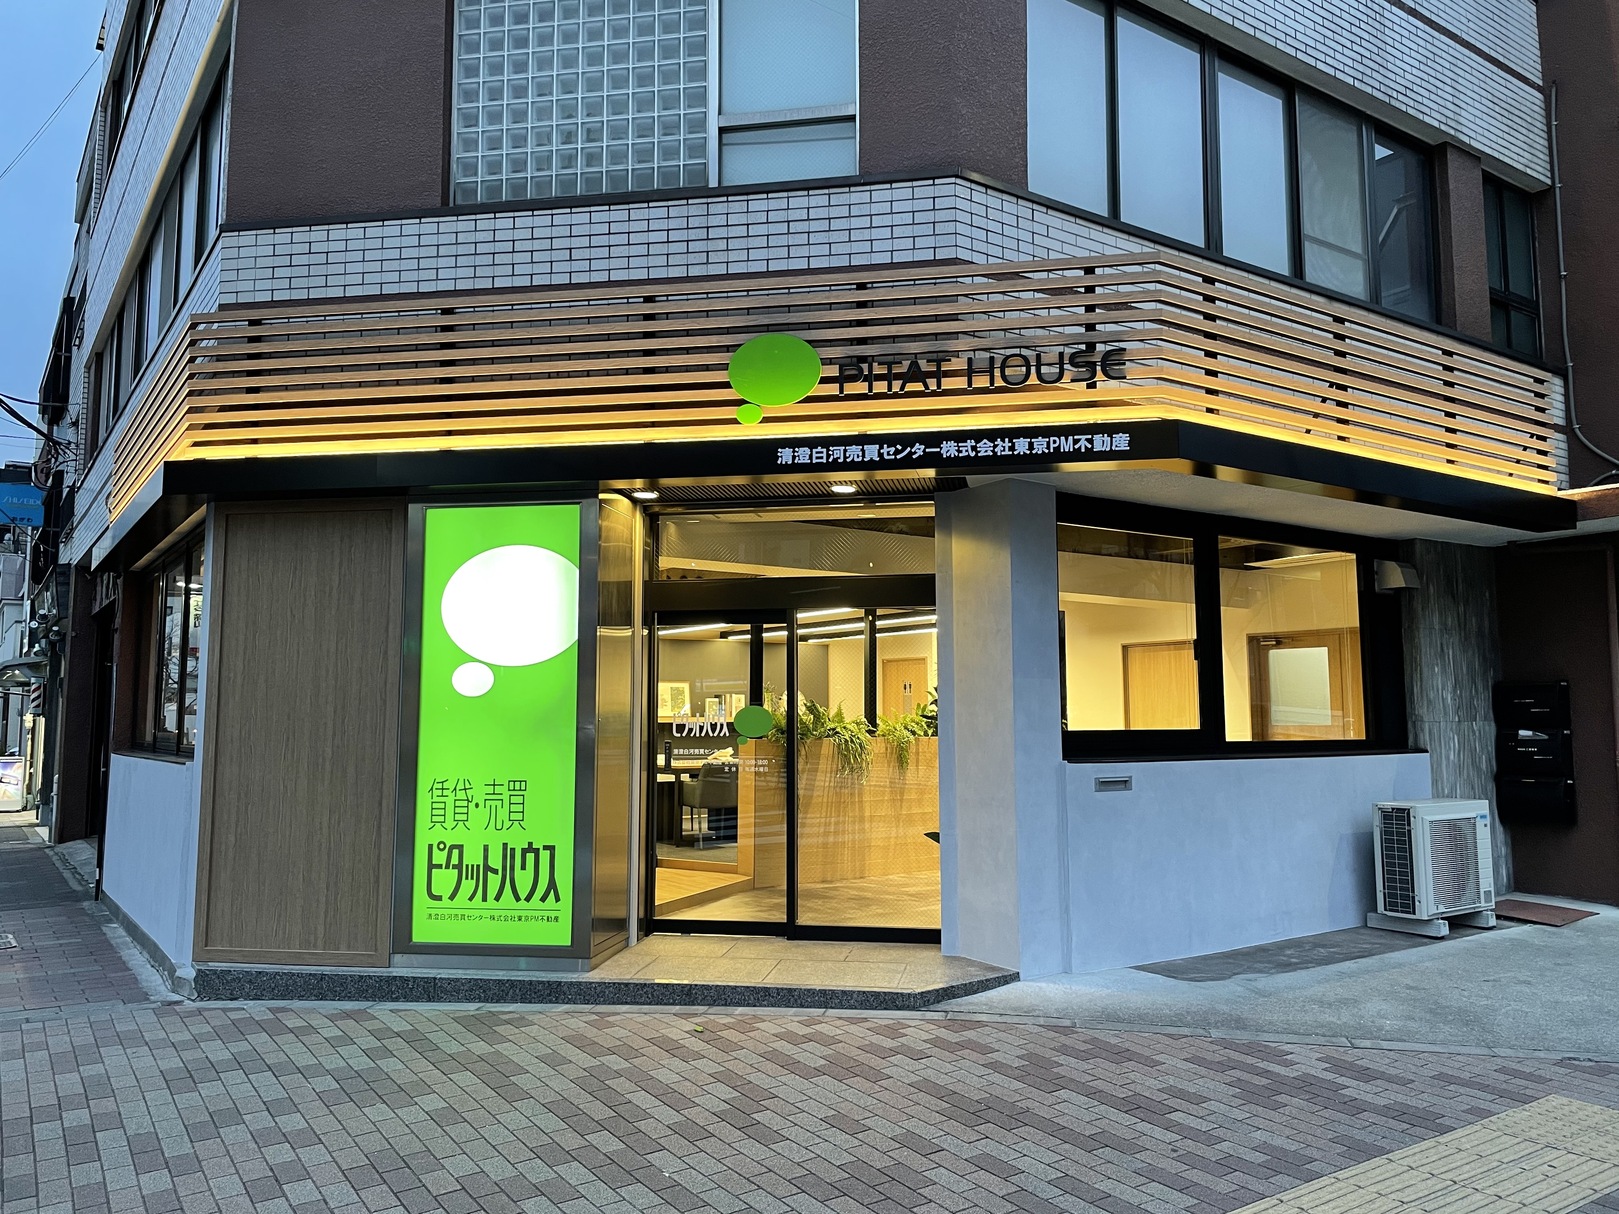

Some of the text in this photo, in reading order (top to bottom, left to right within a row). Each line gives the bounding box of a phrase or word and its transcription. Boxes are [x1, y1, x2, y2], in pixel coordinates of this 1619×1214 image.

[838, 347, 1128, 396] PITAT HOUSE
[777, 433, 1131, 465] 清澄白河売買センター株式会社東京PM不動産
[426, 840, 562, 904] ピタットハウス
